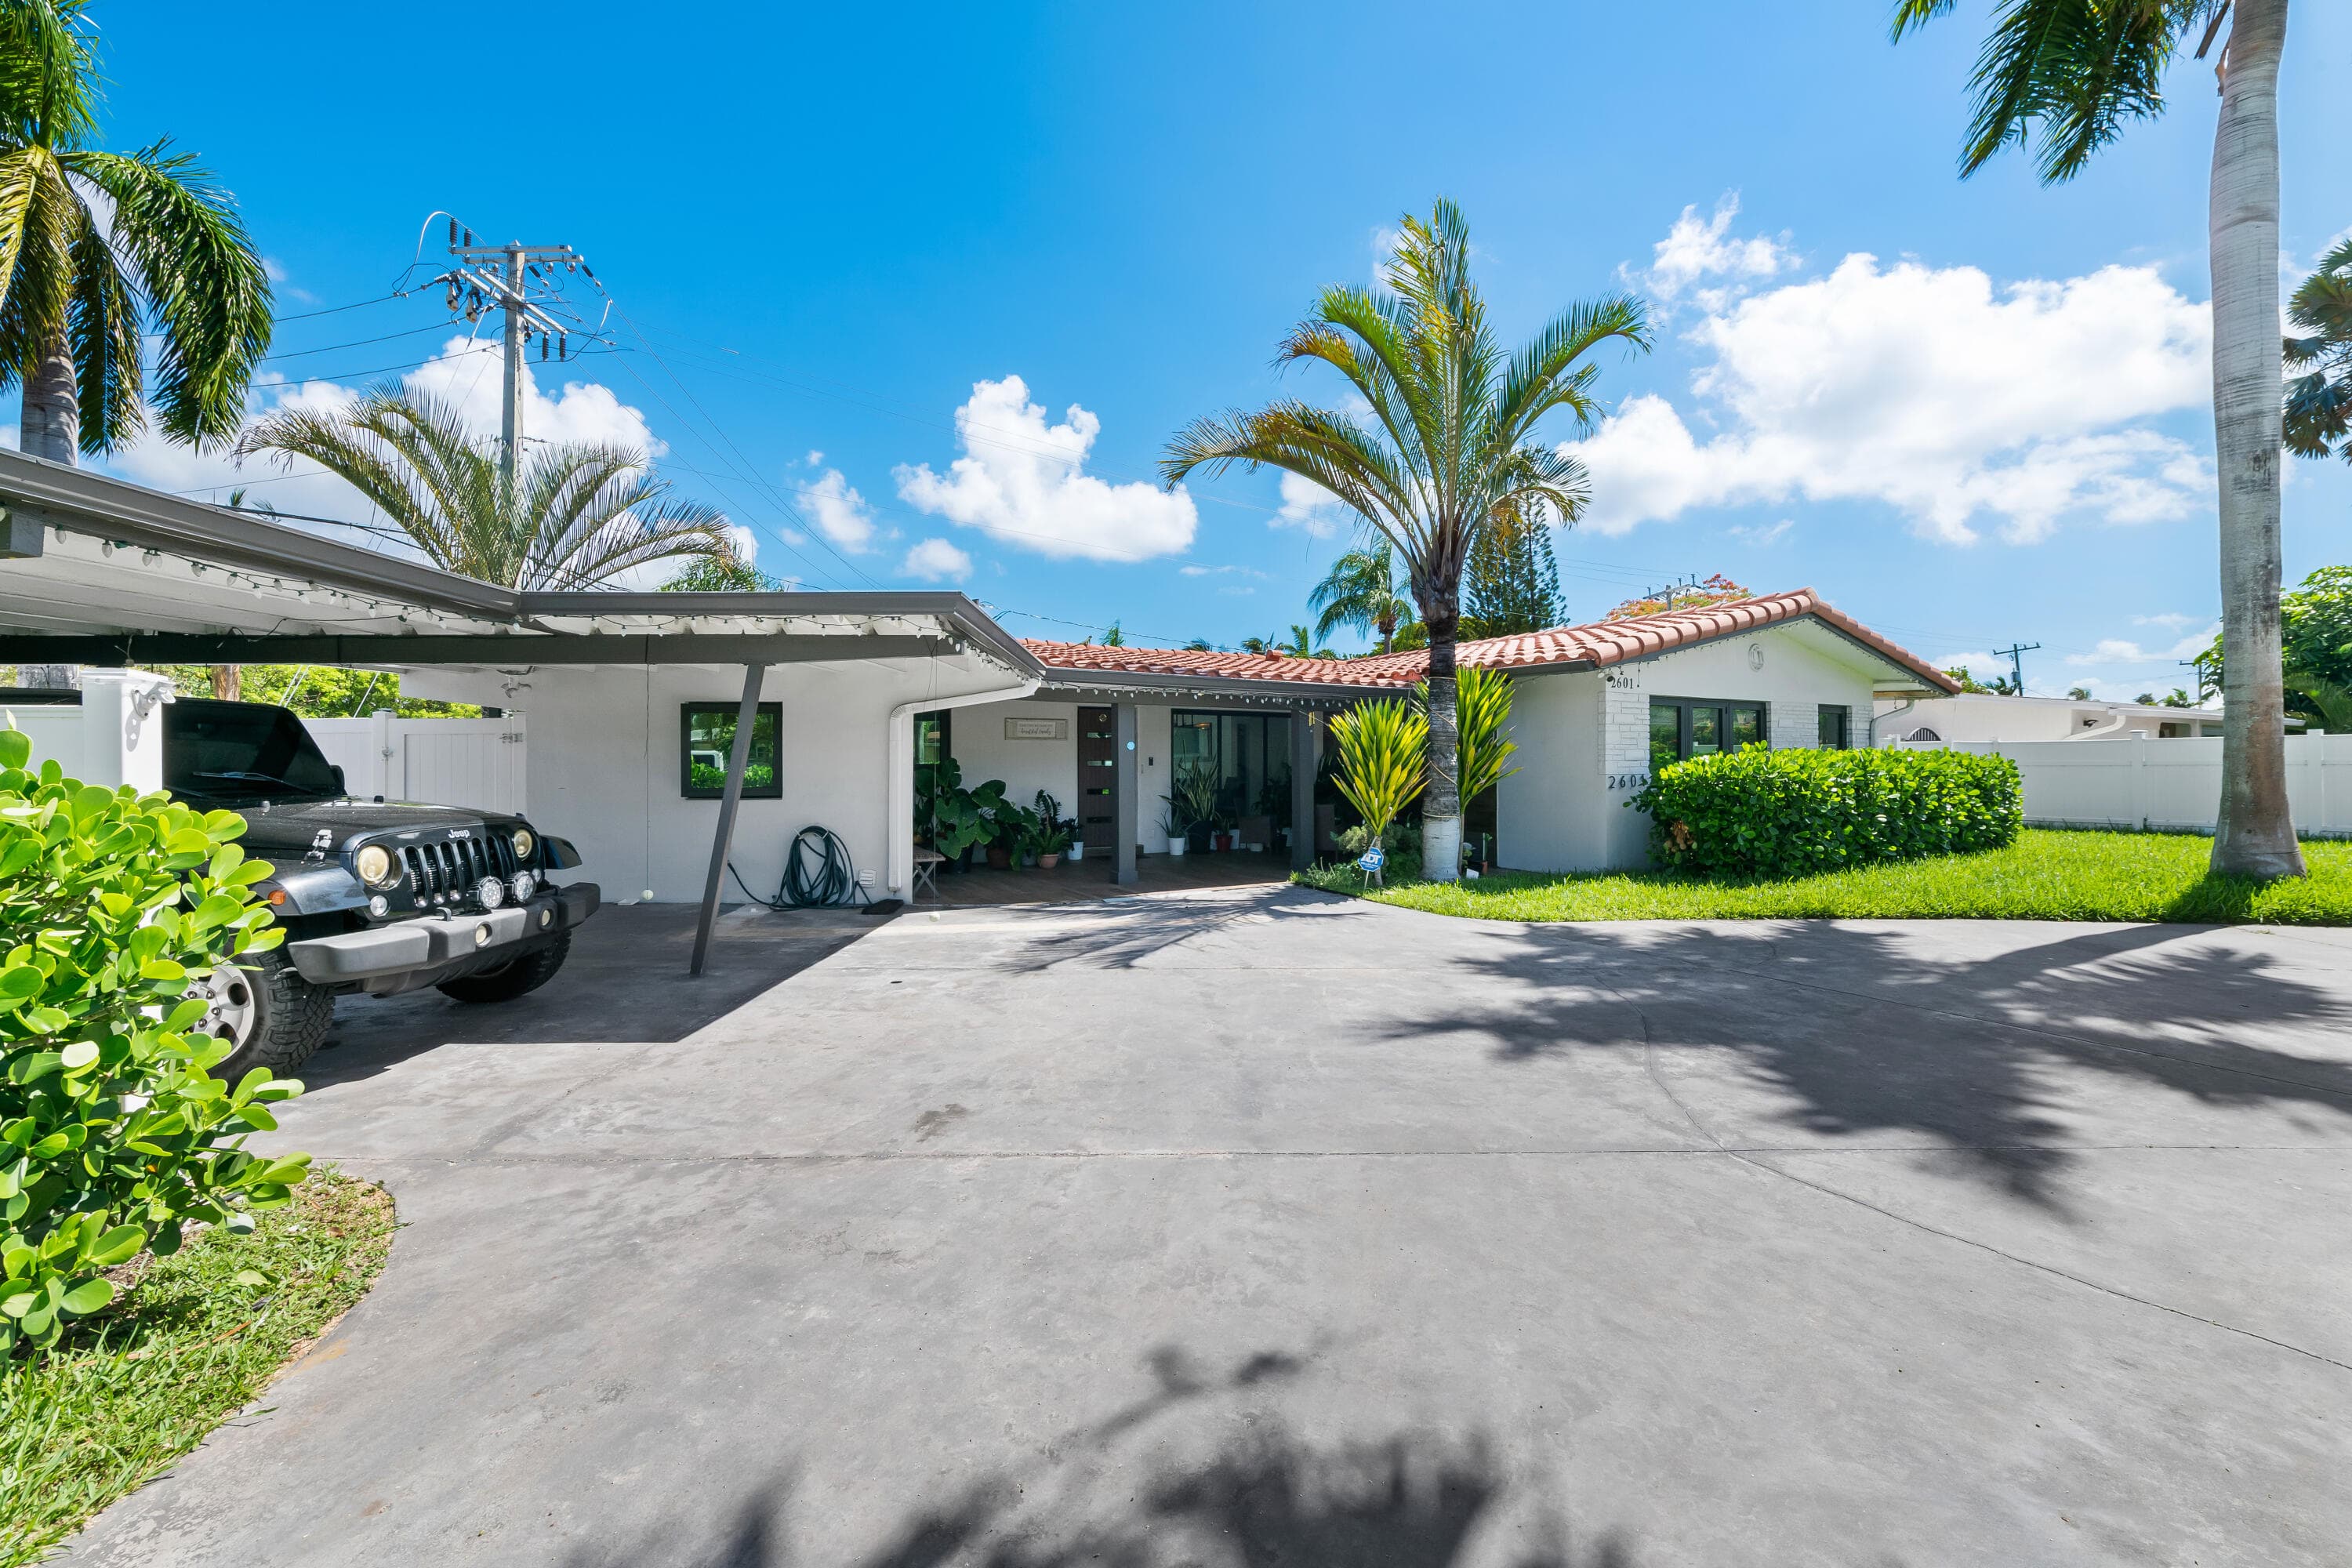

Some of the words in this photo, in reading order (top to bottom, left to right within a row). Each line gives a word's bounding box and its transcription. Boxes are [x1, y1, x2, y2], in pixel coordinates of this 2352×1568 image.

[1611, 677, 1633, 689] 2601
[448, 829, 470, 839] Jeep
[1360, 853, 1381, 864] ADT
